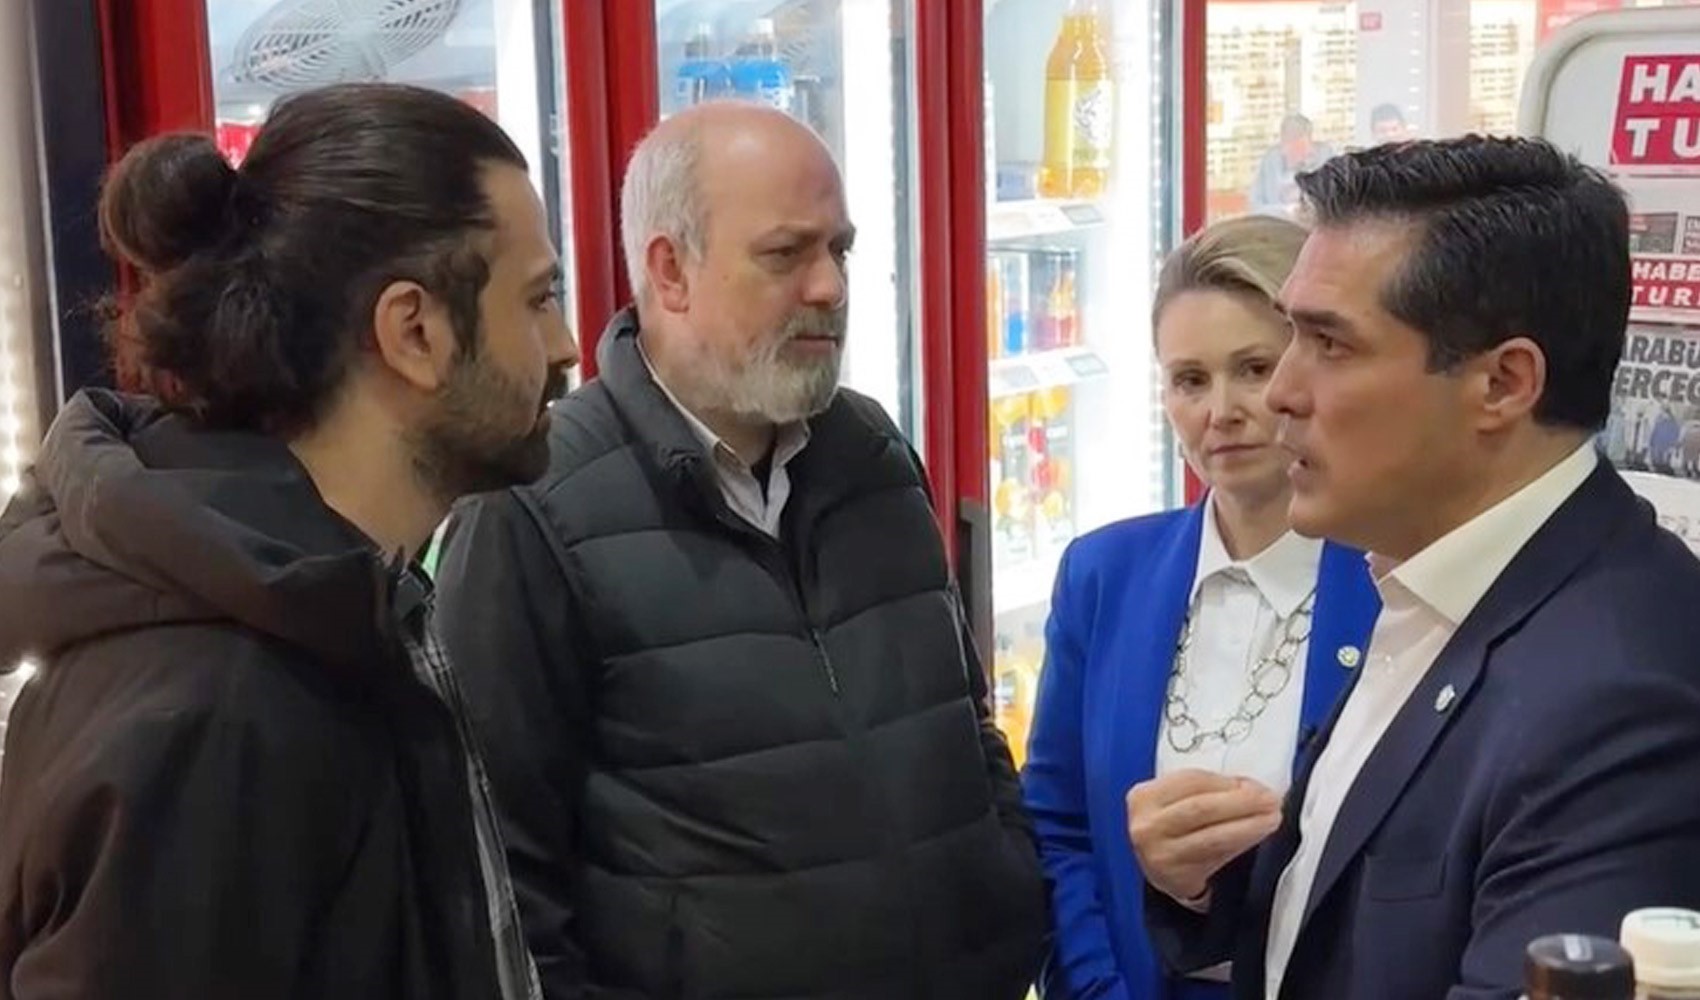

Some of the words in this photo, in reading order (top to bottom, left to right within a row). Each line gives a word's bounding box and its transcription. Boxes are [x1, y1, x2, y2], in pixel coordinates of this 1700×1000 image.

[1629, 63, 1700, 103] HA
[1625, 118, 1700, 158] TU
[1632, 261, 1700, 281] HABE
[1632, 286, 1700, 306] TUR
